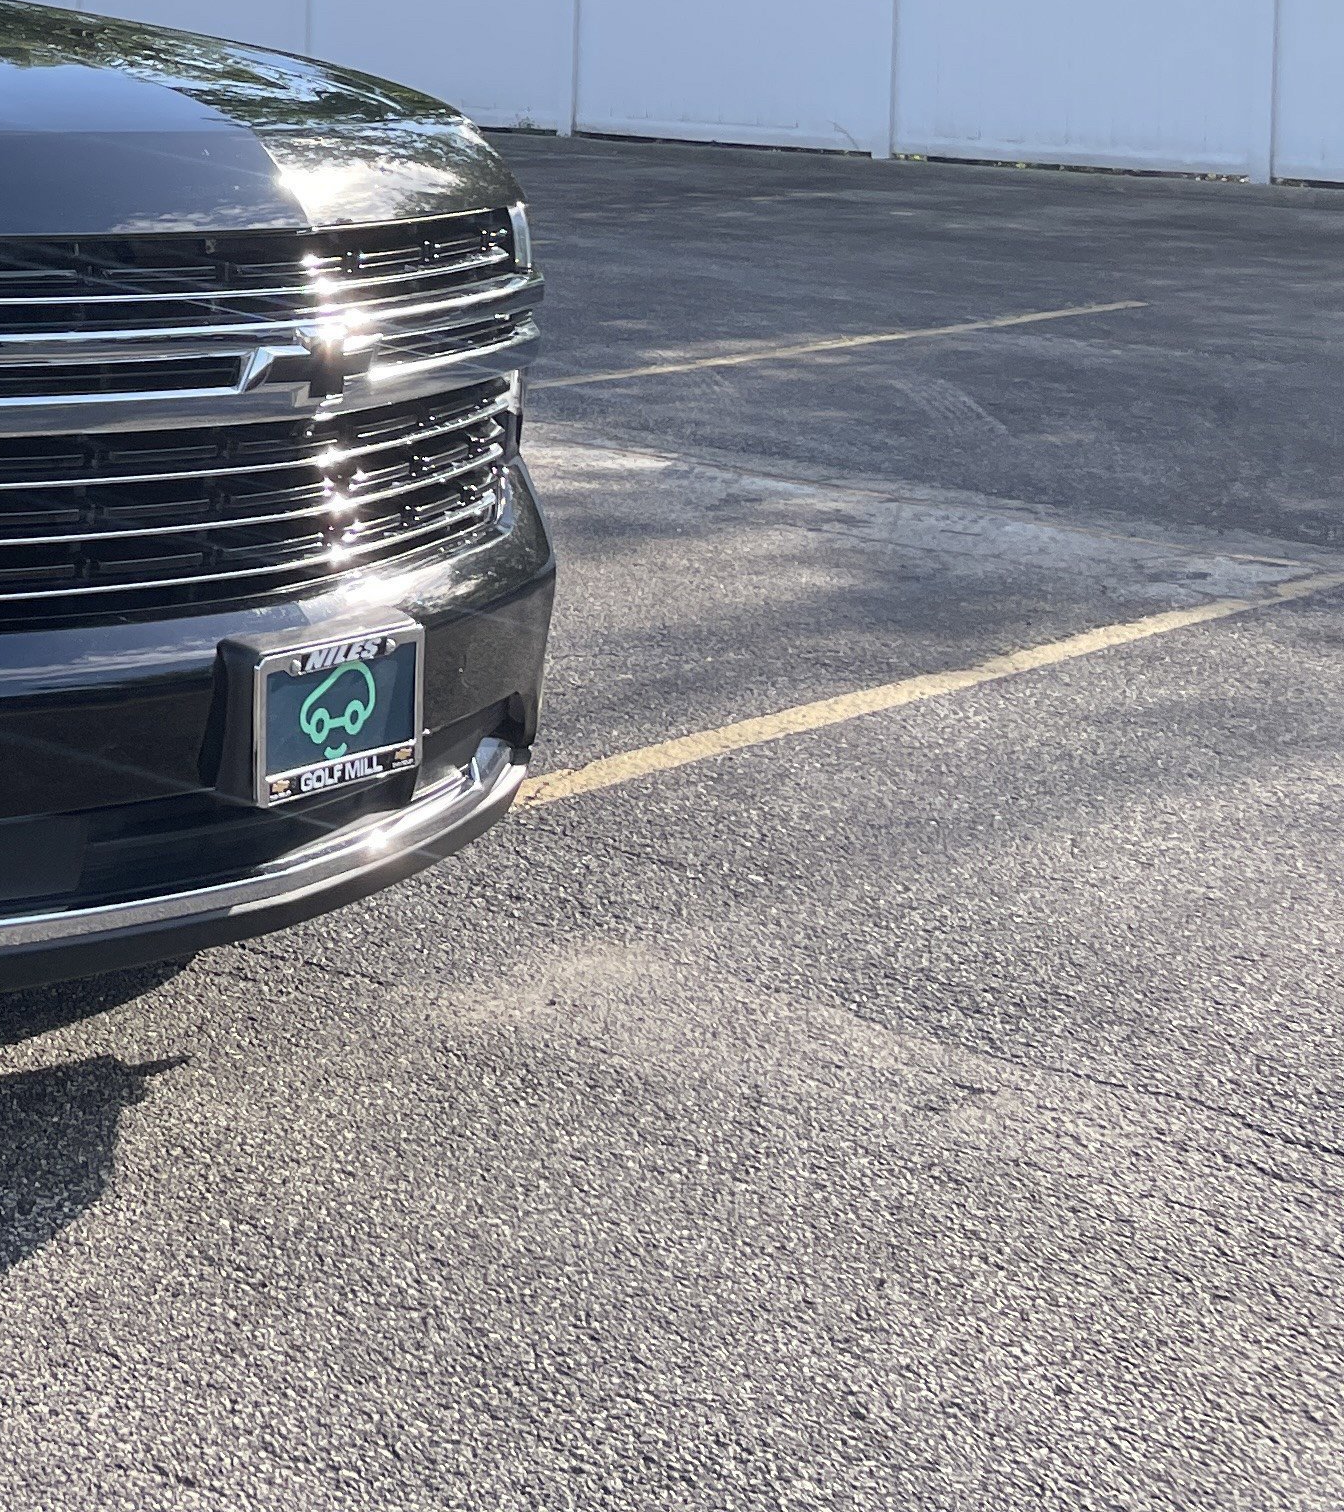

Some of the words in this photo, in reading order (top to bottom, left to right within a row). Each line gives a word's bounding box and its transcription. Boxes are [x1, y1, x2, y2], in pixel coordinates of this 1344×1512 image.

[305, 637, 382, 672] NILES
[300, 763, 343, 792] GOLF
[344, 755, 384, 780] MILL
